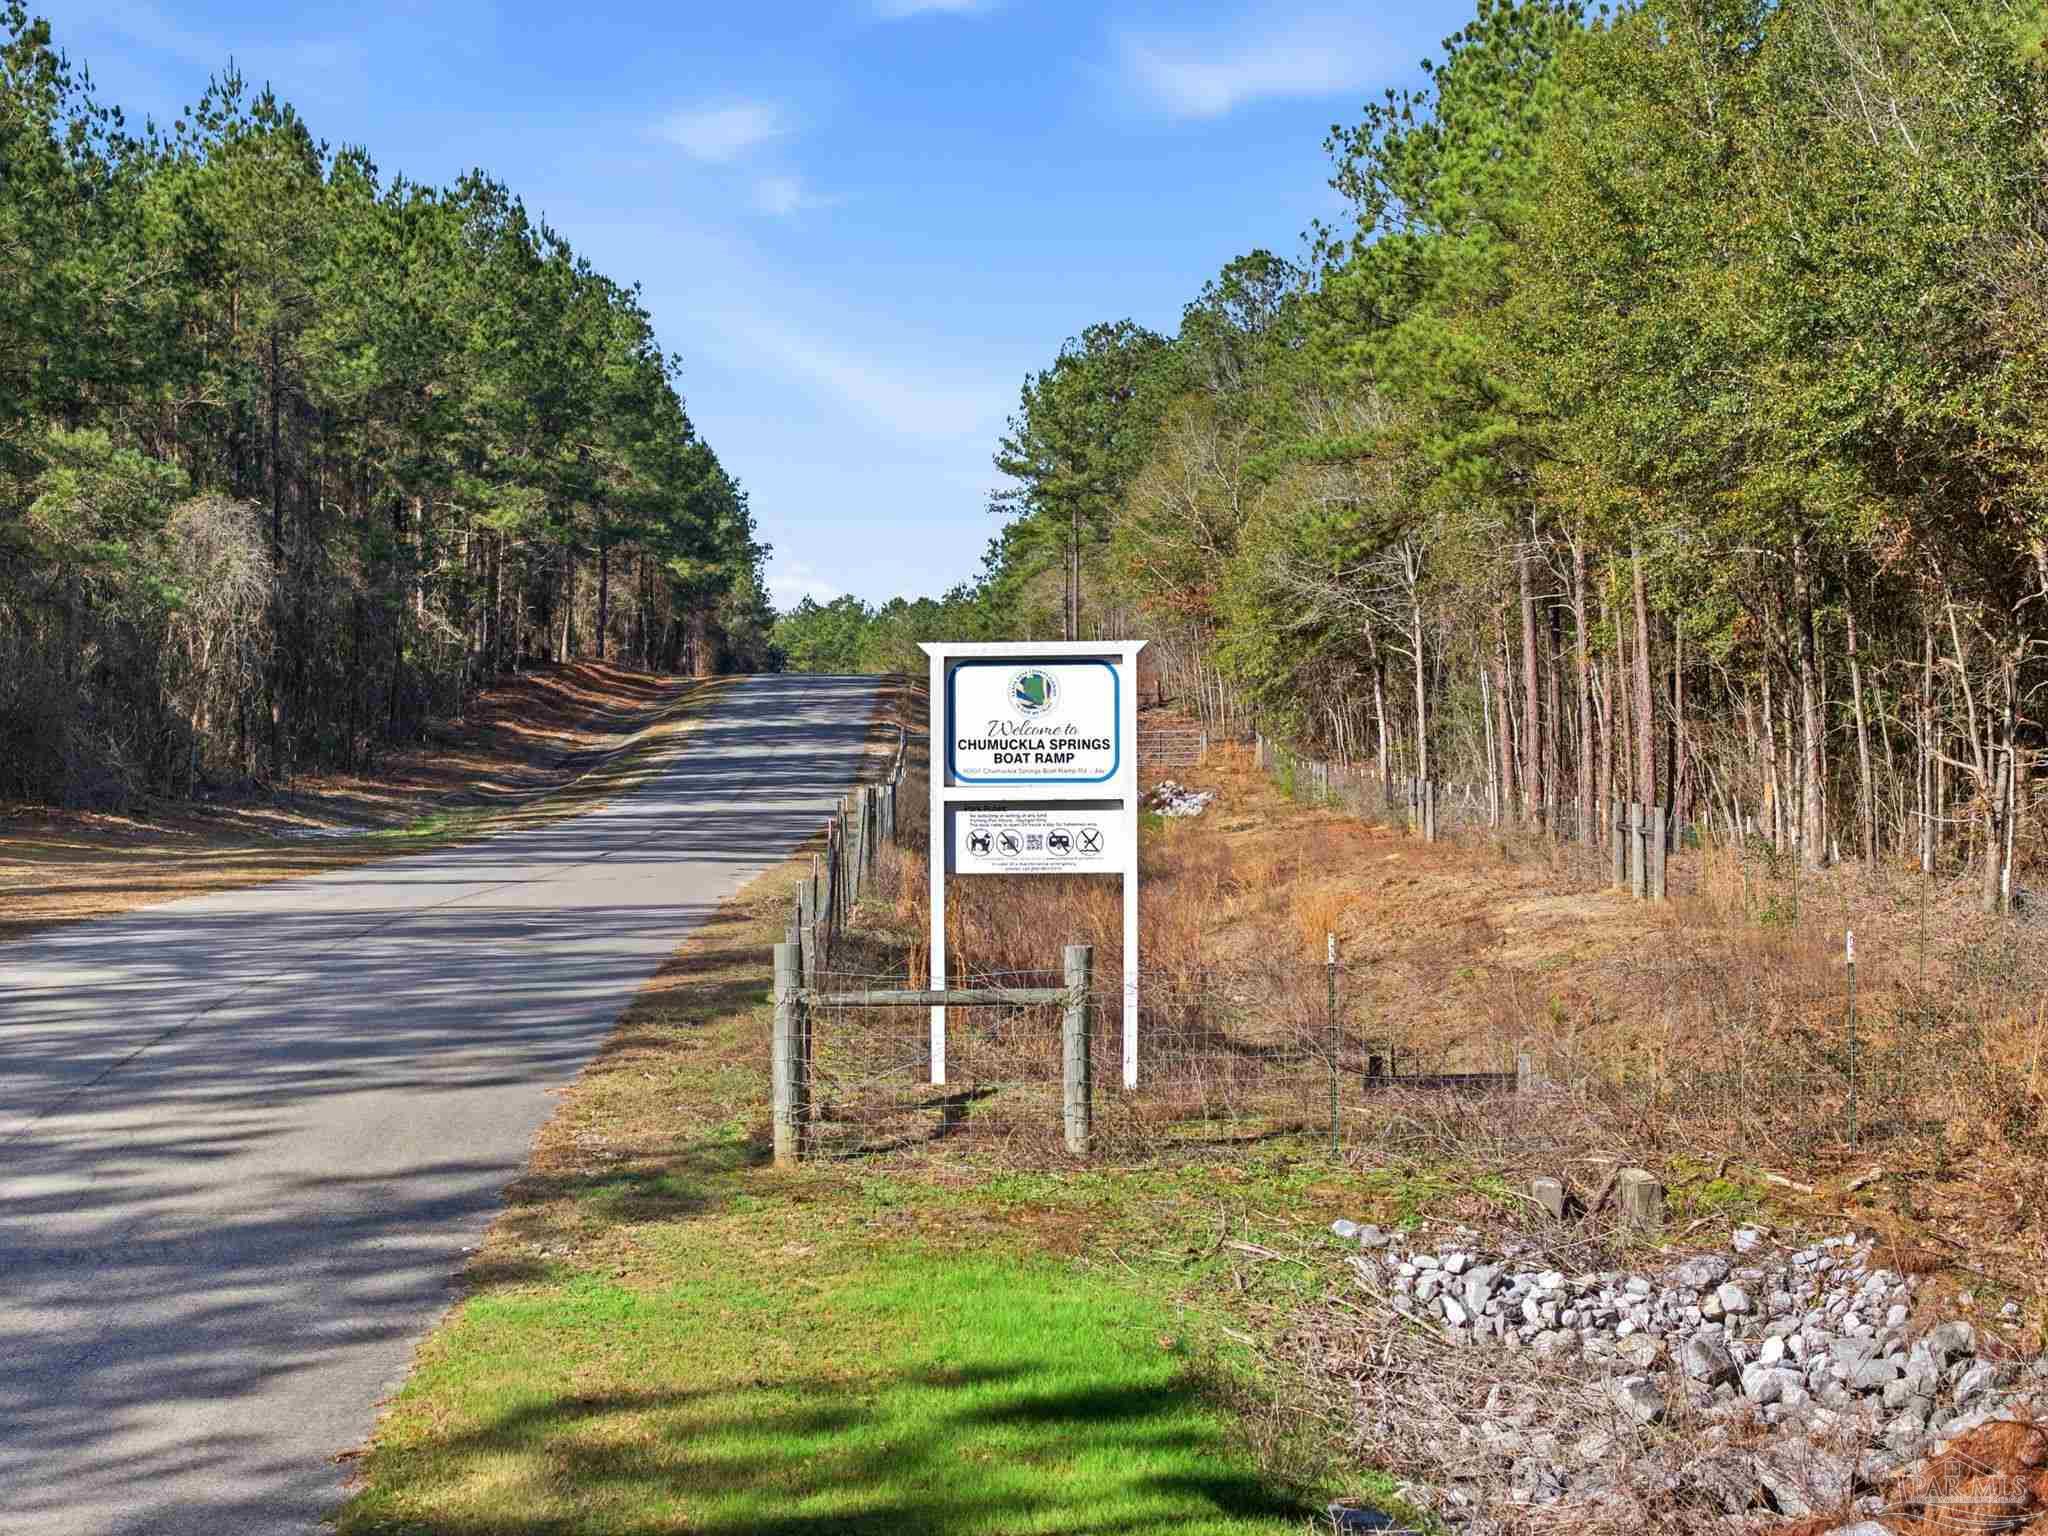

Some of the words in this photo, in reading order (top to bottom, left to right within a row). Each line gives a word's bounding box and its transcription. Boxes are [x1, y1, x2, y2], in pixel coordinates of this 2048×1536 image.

[988, 720, 1063, 737] Welcome
[1065, 722, 1078, 737] to
[958, 738, 1045, 750] CHUMUCKLA
[1049, 738, 1111, 750] SPRINGS
[994, 752, 1029, 764] BOAT
[1035, 752, 1075, 764] RAMP
